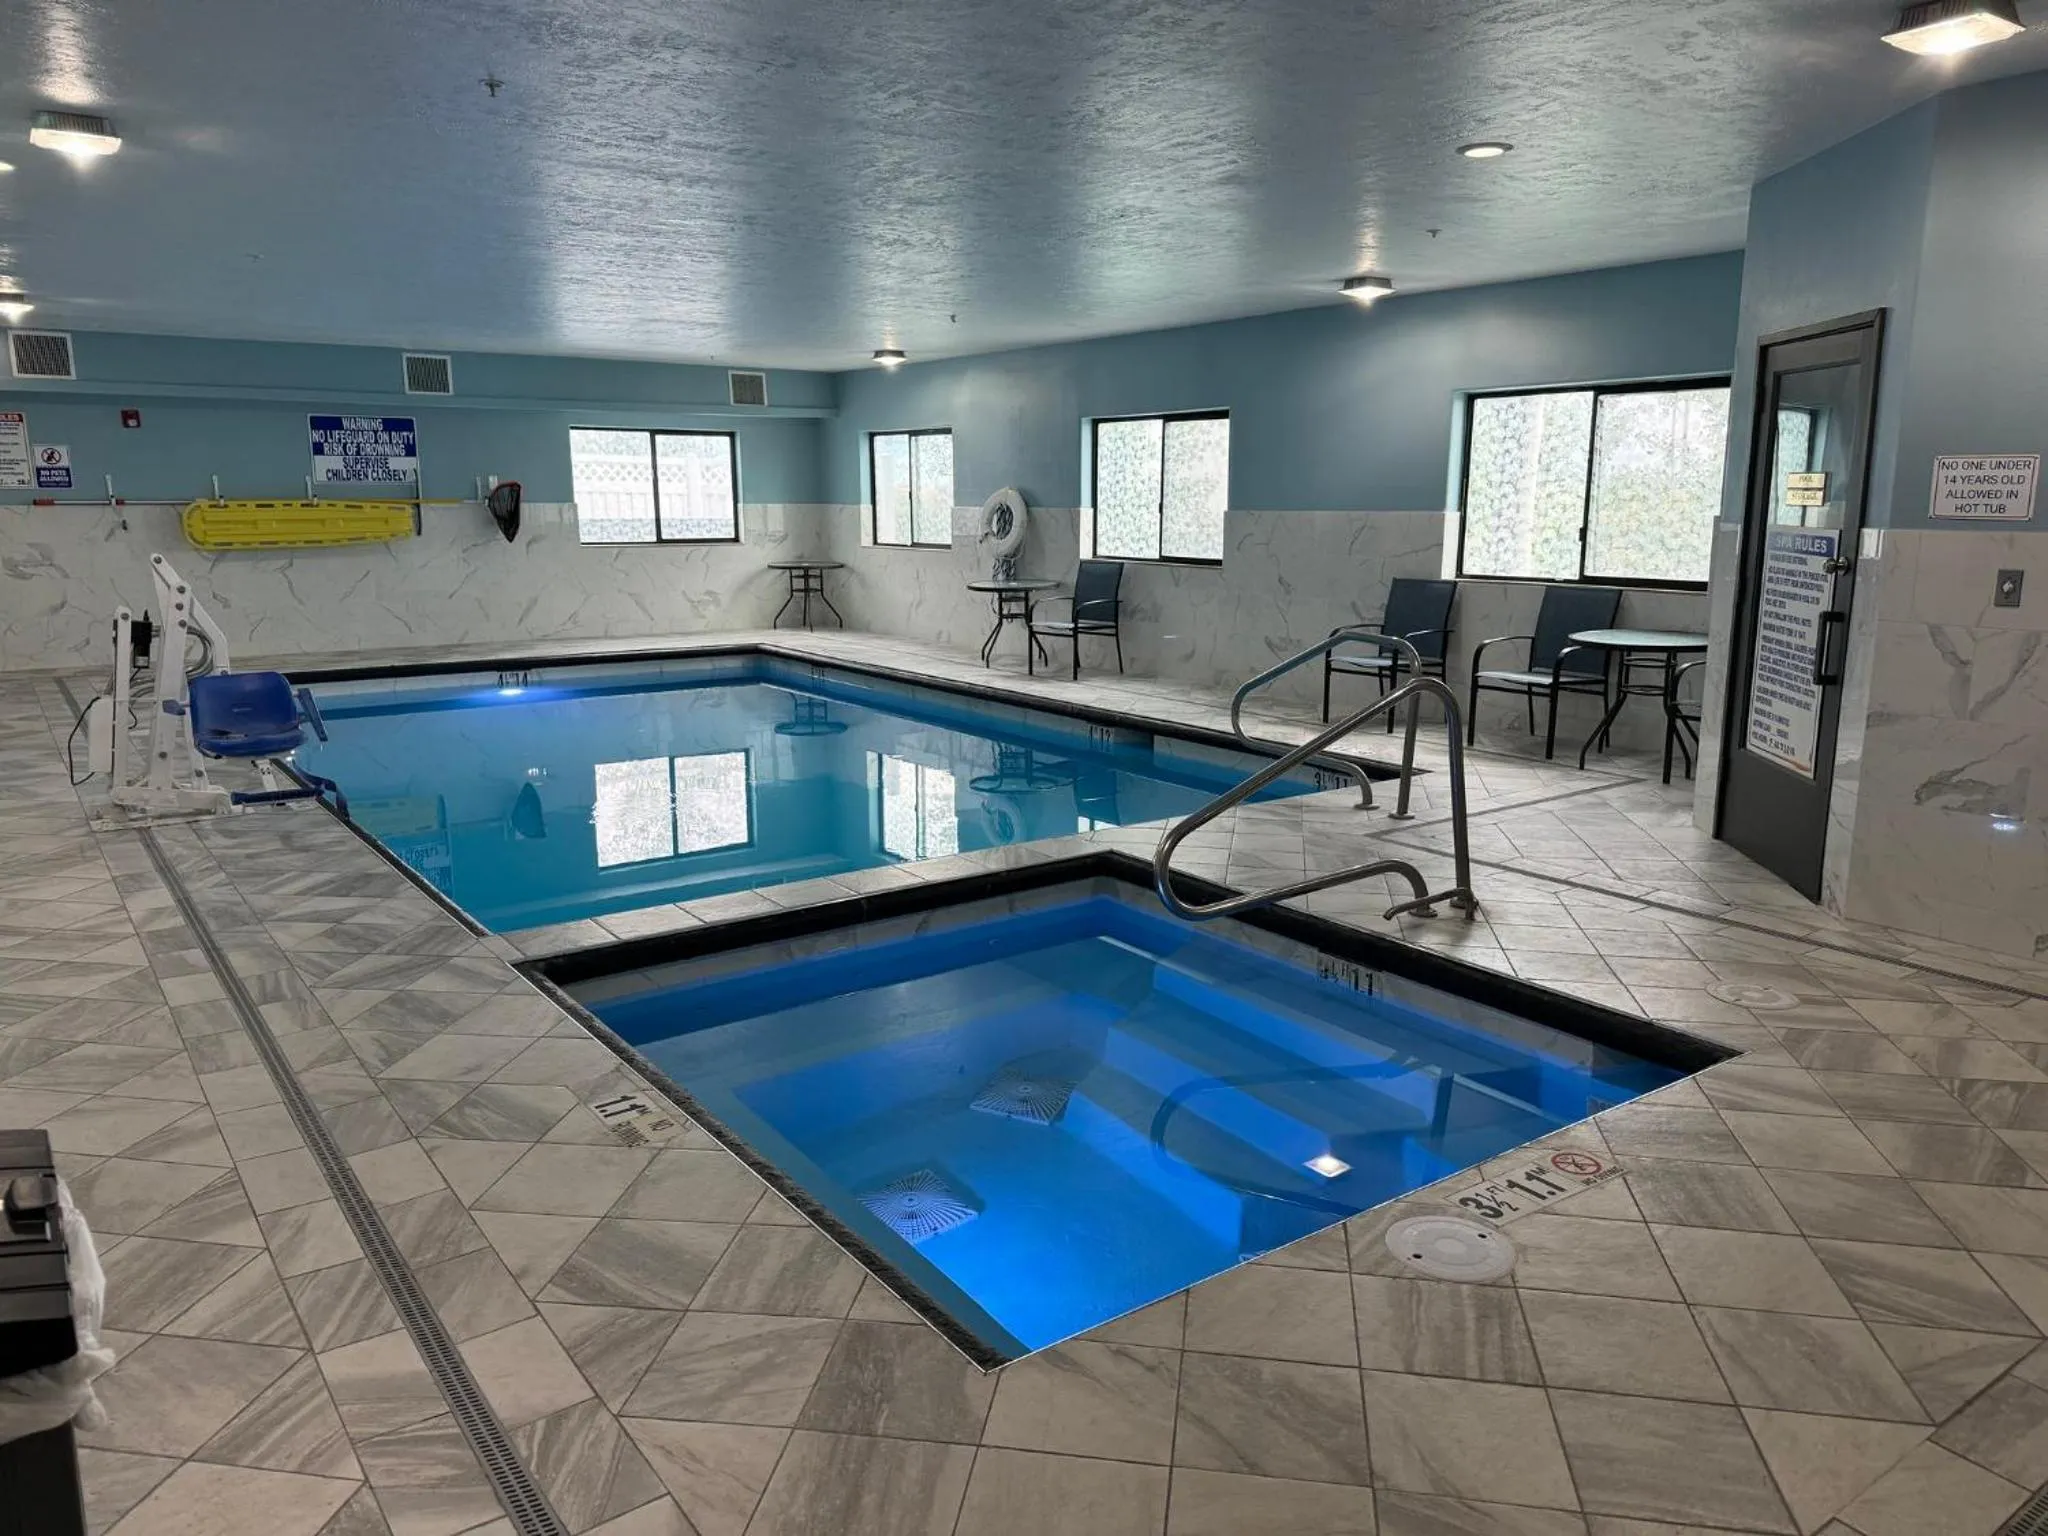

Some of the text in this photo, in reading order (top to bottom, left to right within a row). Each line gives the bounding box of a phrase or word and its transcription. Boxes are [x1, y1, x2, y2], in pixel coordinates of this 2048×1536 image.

[342, 417, 383, 430] WARNING
[312, 430, 413, 444] NO LIFEGUARD ON DUTY
[323, 443, 405, 456] RISK OF DROWNING
[343, 457, 389, 469] SUPERVISE
[1941, 460, 2031, 470] NO ONE UNDER
[326, 469, 407, 481] CHILDREN CLOSELY
[1944, 475, 2025, 484] 14 YEARS OLD
[1945, 489, 2018, 499] ALLOWED IN
[1954, 504, 2006, 513] HOT TUB
[1794, 538, 1828, 554] RULES
